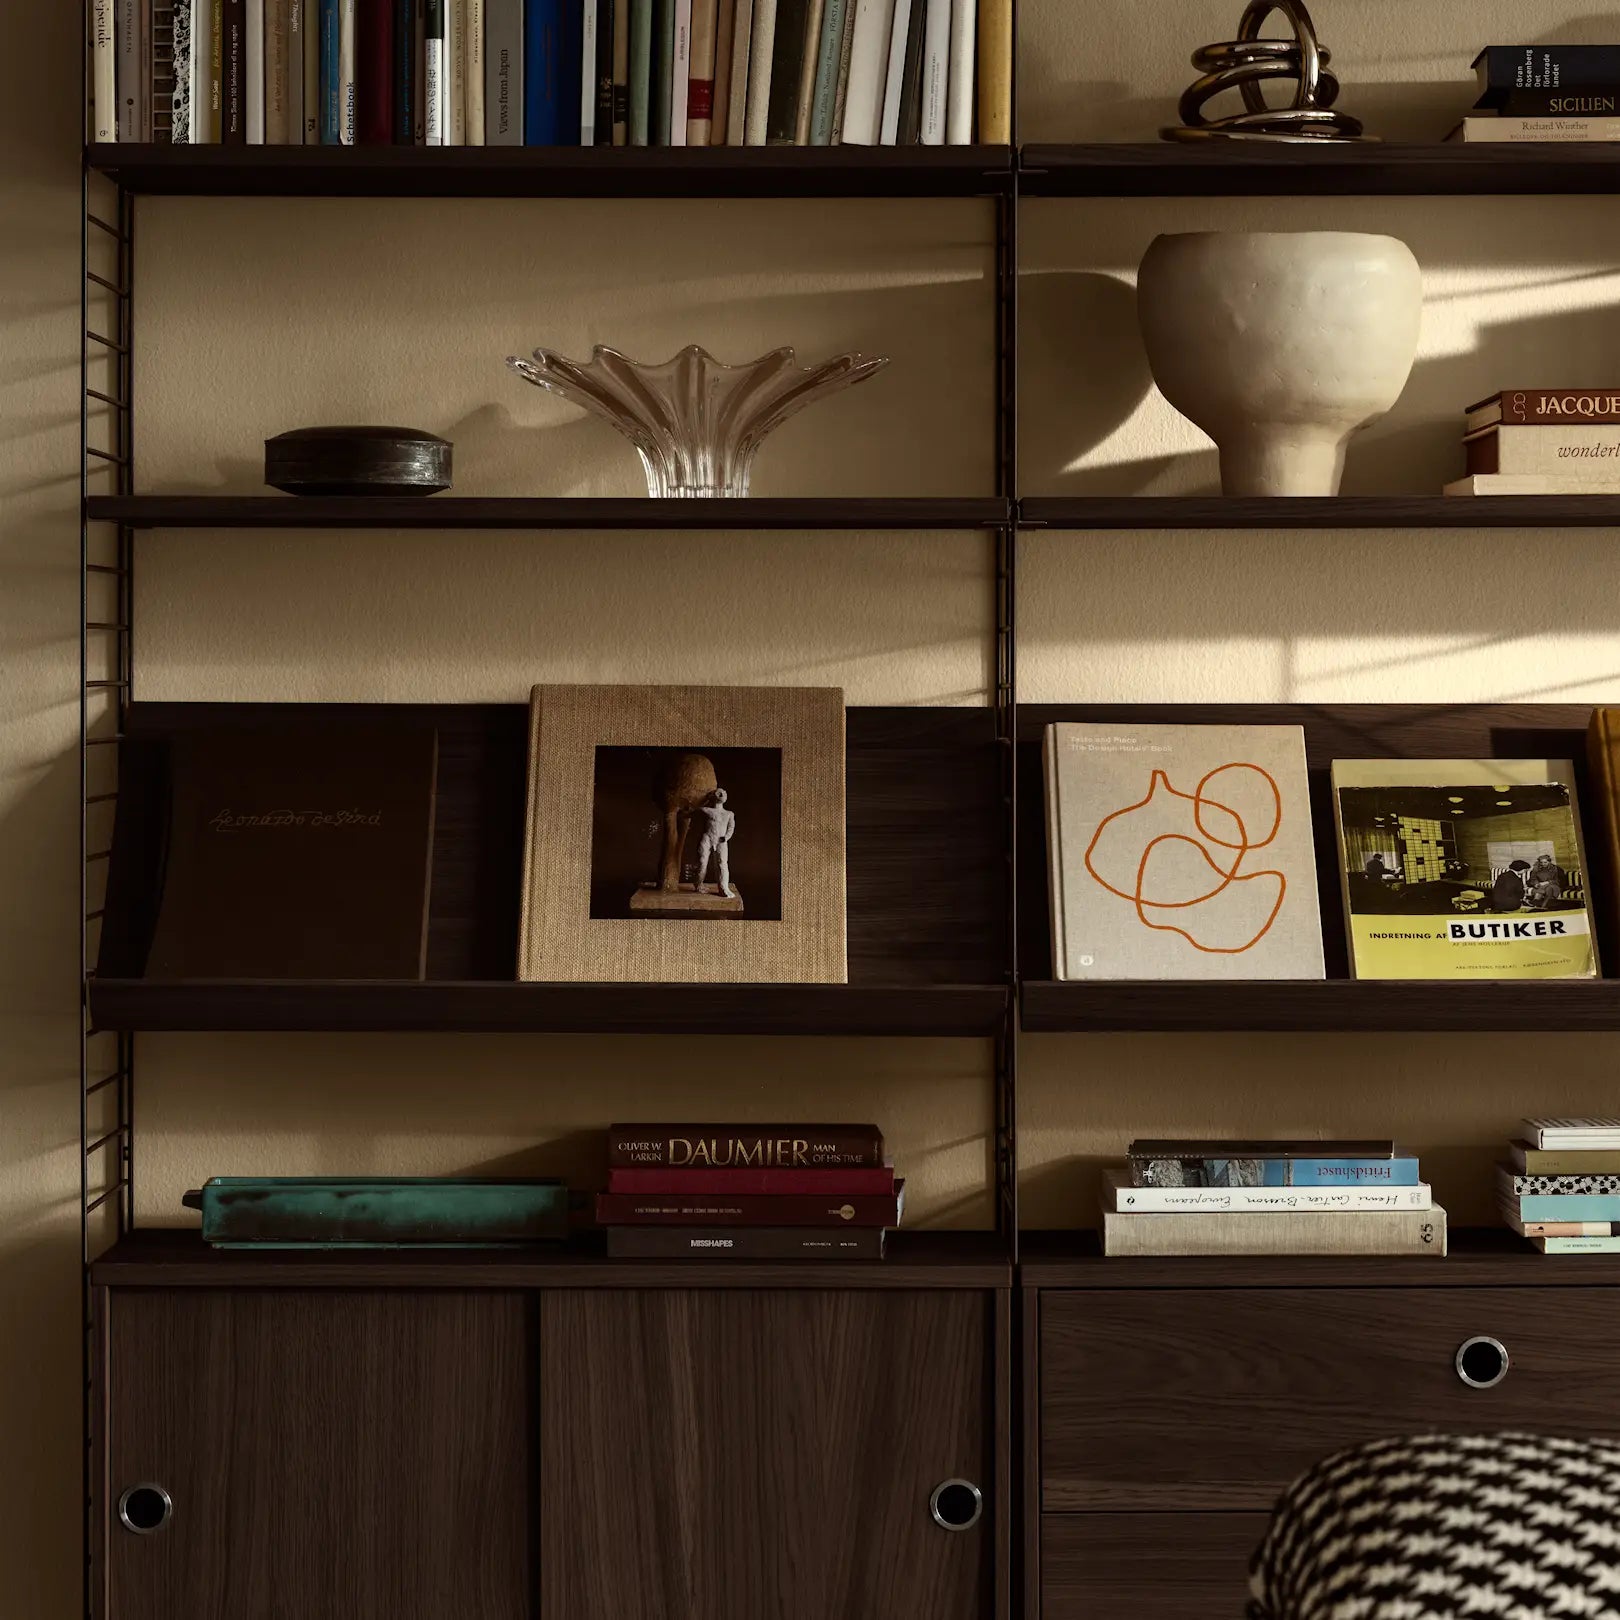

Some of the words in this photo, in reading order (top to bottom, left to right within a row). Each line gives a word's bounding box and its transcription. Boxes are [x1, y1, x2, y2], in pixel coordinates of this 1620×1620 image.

[291, 4, 299, 32] Thoughts
[500, 49, 510, 78] Japan
[1525, 49, 1533, 87] Rosenberg
[499, 80, 508, 103] from
[1549, 96, 1615, 112] SICILIEN
[347, 82, 355, 142] Schetsboek
[499, 105, 507, 134] Views
[1522, 121, 1554, 130] Richard
[1151, 745, 1173, 753] Book
[1450, 920, 1567, 939] BUTIKER
[618, 1142, 649, 1151] OLIVER
[650, 1142, 662, 1151] W.
[668, 1138, 809, 1166] DAUMIER
[813, 1144, 836, 1152] MAN
[631, 1153, 661, 1161] LARKIN
[813, 1154, 826, 1162] OF
[827, 1154, 841, 1162] HIS
[843, 1154, 863, 1163] TIME
[1317, 1166, 1392, 1179] Fritidshuset
[1164, 1195, 1231, 1210] Europeans
[1358, 1194, 1398, 1205] Henri
[690, 1239, 733, 1248] MISSHAPES
